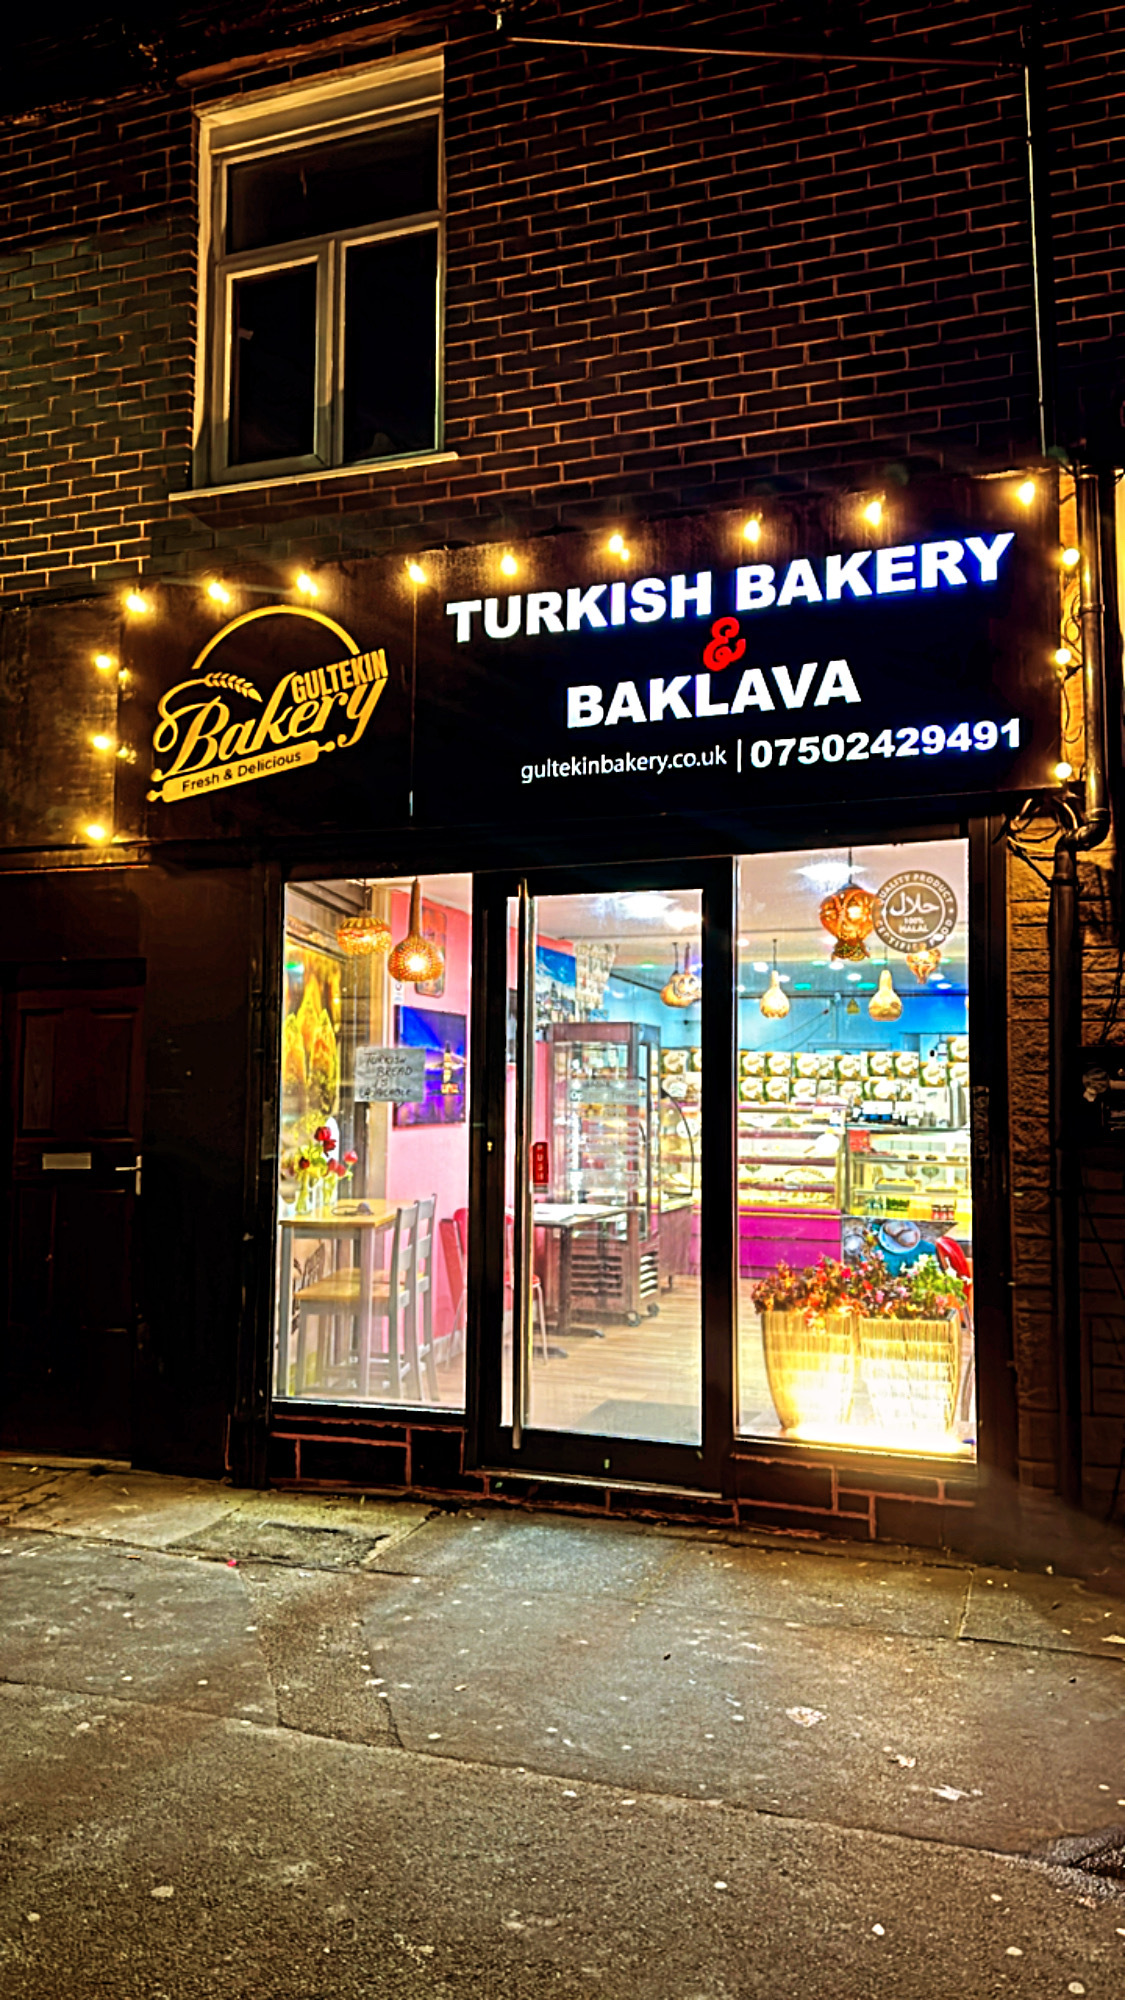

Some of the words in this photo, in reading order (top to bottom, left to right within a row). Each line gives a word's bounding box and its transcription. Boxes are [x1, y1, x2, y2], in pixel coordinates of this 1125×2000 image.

[446, 571, 712, 643] TURKISH
[736, 533, 1016, 612] BAKERY
[703, 617, 746, 671] &
[290, 648, 389, 704] GULTEKIN
[566, 659, 862, 729] BAKLAVA
[152, 671, 388, 782] Bakery
[182, 771, 219, 792] Fresh
[223, 769, 233, 782] &
[238, 751, 301, 777] Delicious
[521, 744, 728, 785] gultekinbakery.co.uk
[750, 718, 1021, 769] 07502429491
[889, 891, 940, 916] حلال
[913, 873, 954, 903] PRODUCT
[898, 925, 930, 934] HALAL
[928, 918, 953, 947] FOD
[376, 1066, 414, 1078] BREAD
[535, 1143, 545, 1181] PUSH
